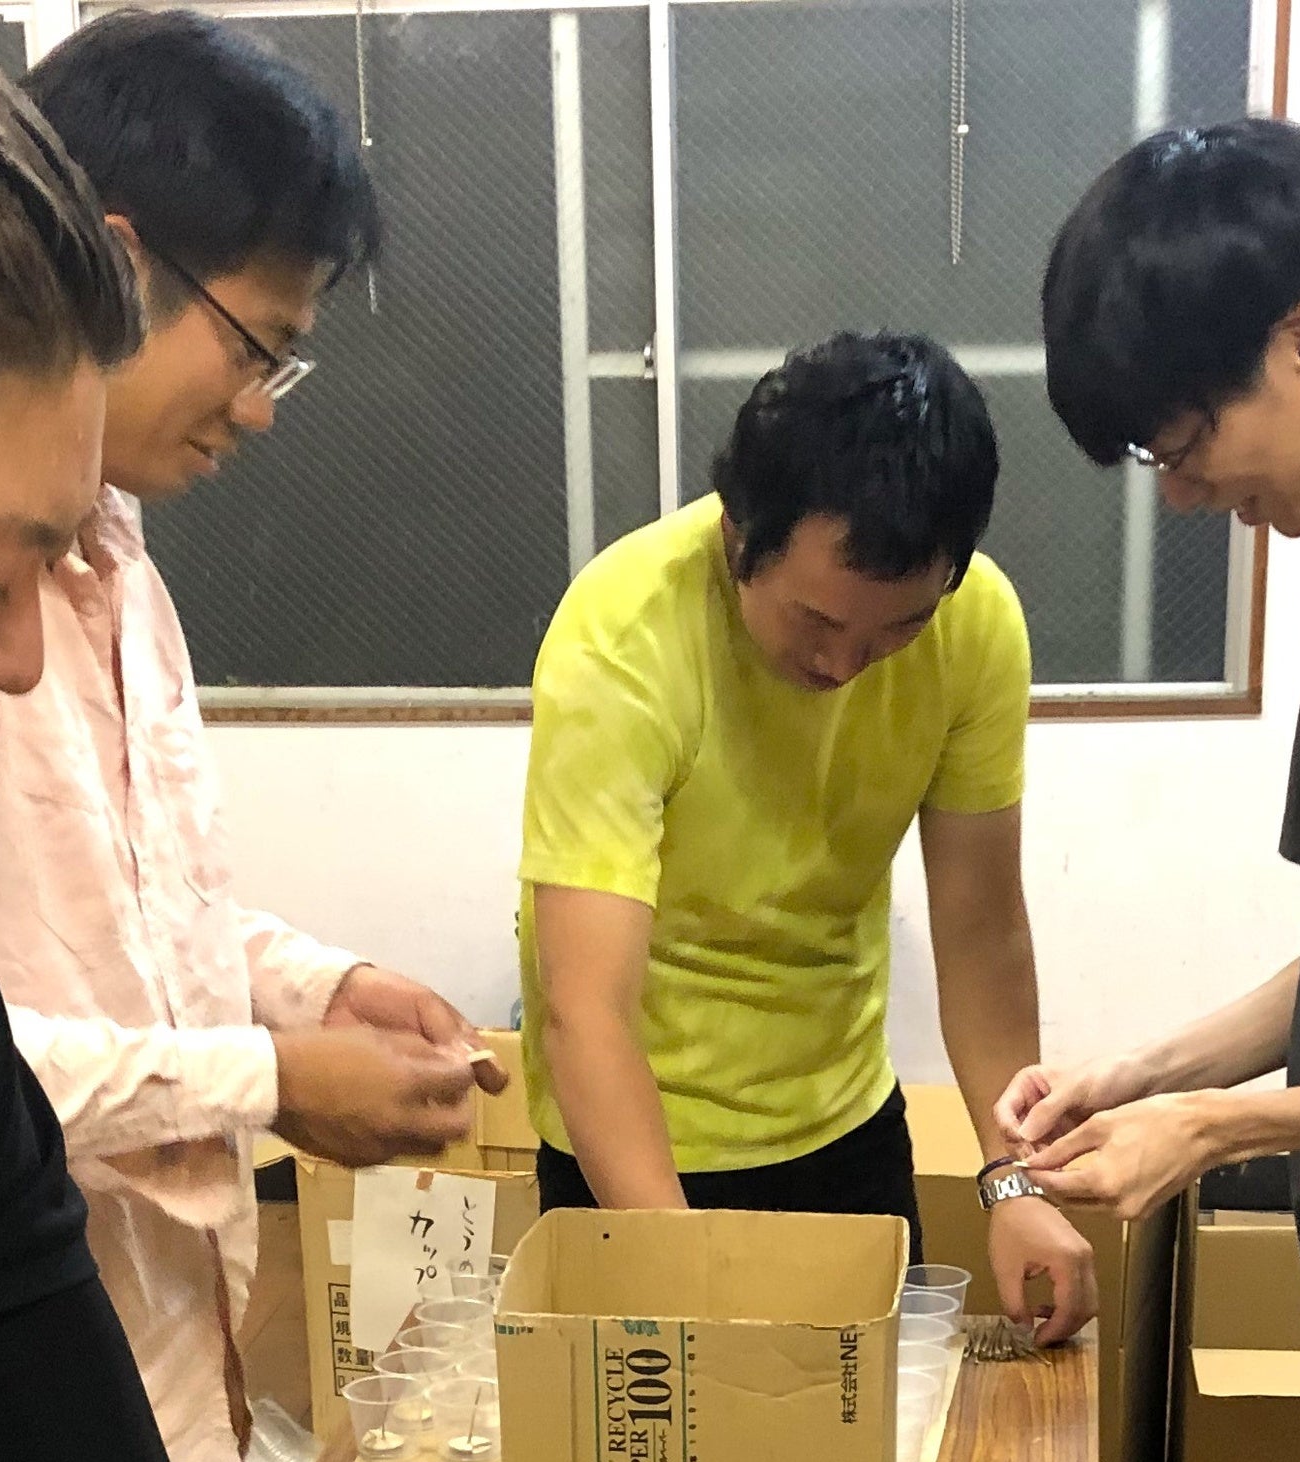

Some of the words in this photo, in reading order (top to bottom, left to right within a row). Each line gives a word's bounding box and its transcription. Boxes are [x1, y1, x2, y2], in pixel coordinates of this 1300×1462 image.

[408, 1210, 438, 1285] カップ
[605, 1347, 627, 1453] RECYCLE
[625, 1348, 673, 1426] 100
